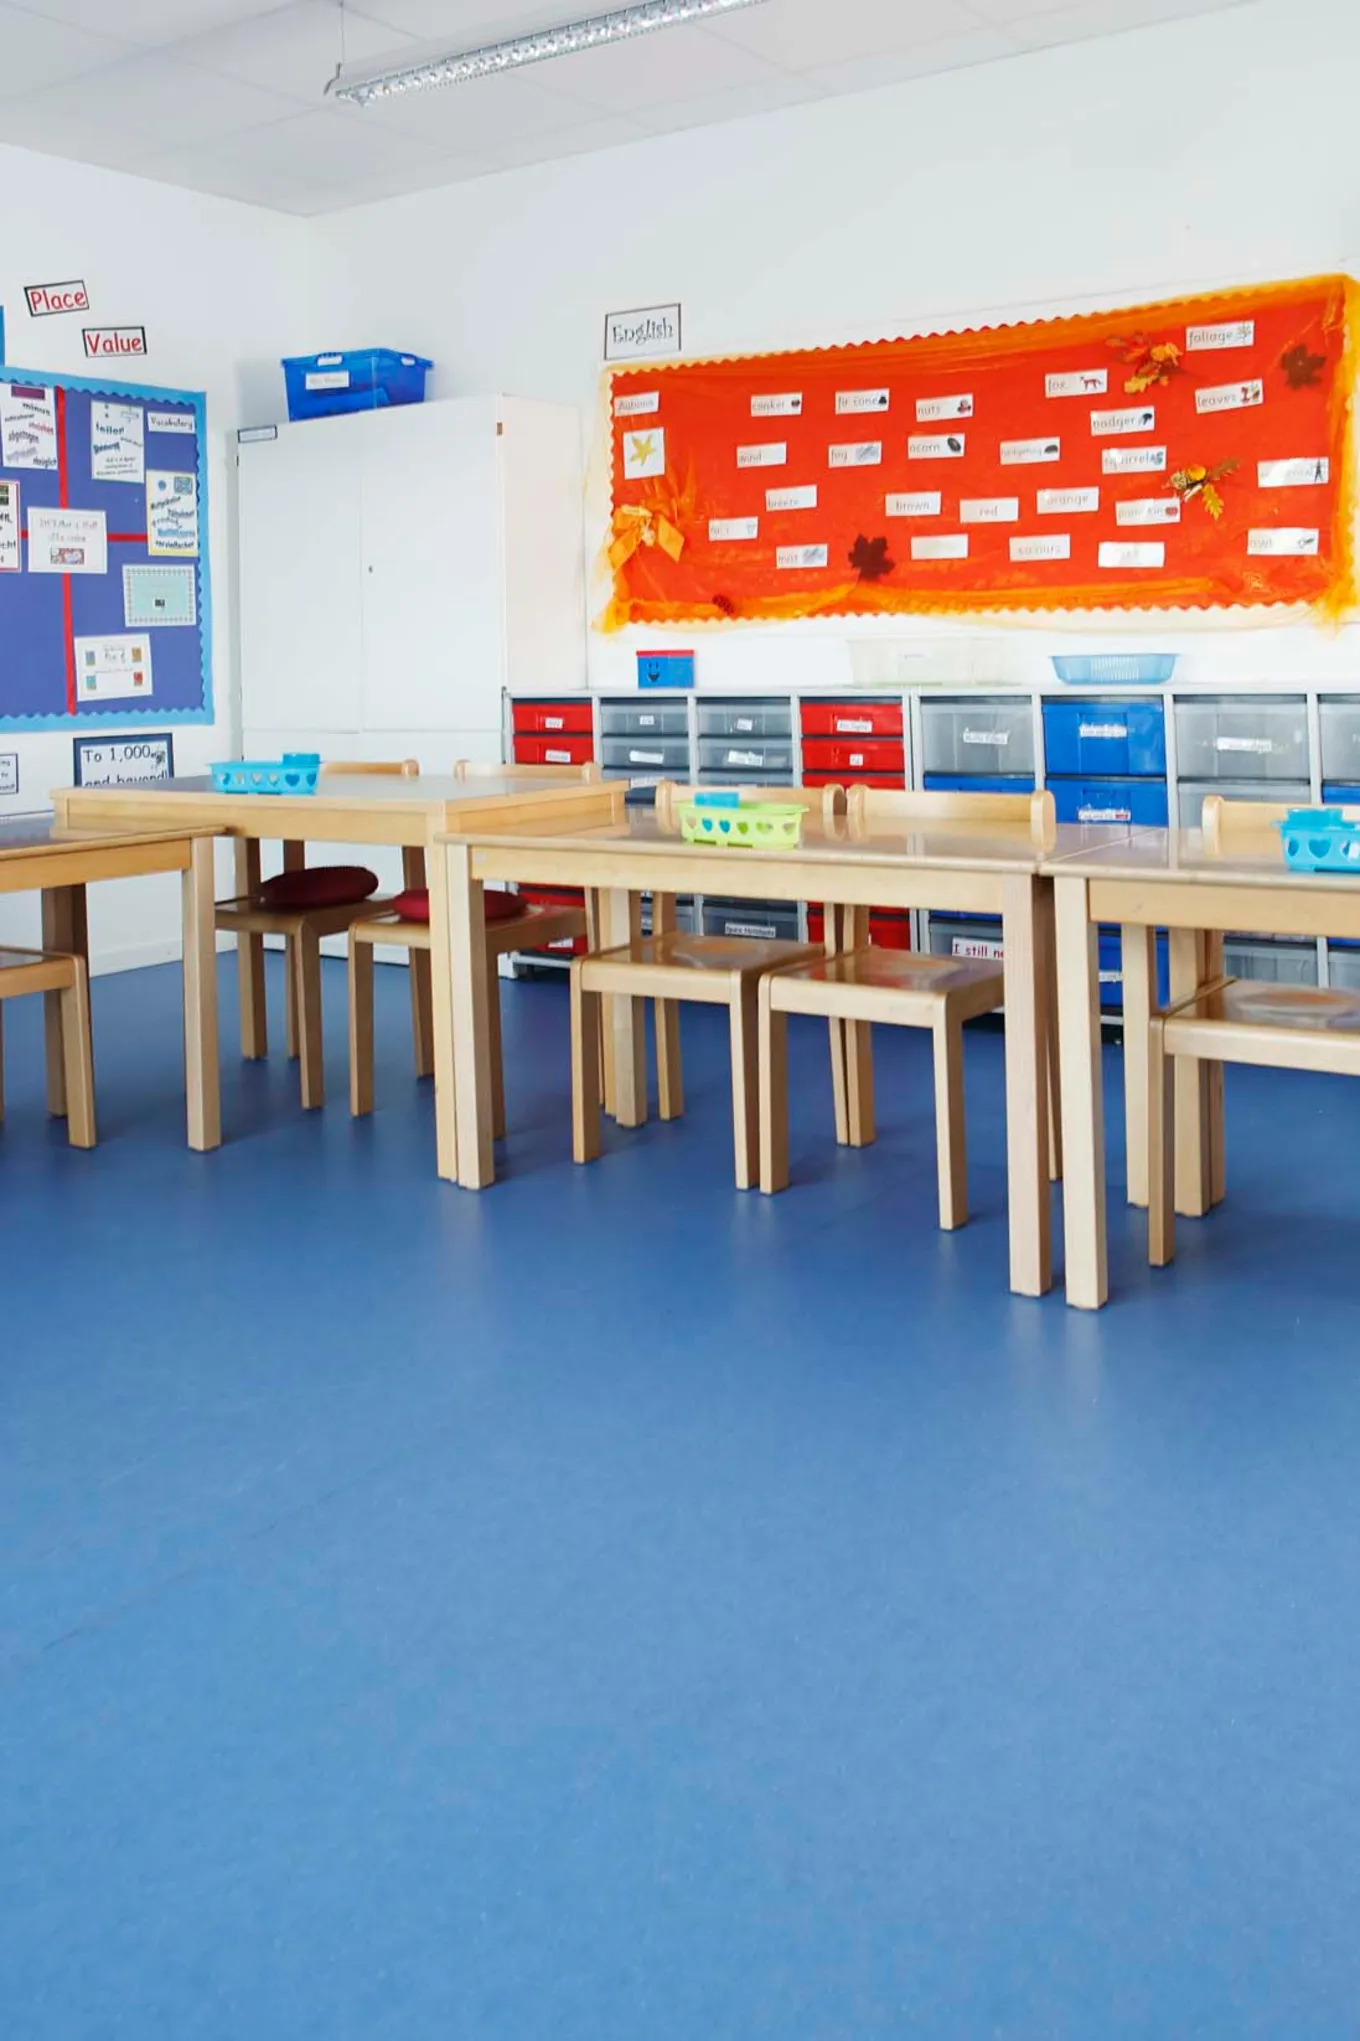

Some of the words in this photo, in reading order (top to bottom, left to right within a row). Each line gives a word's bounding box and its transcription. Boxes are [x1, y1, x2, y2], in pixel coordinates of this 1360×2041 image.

[30, 288, 87, 313] Place
[612, 317, 674, 346] English
[1188, 330, 1233, 347] foliage
[86, 332, 143, 354] Value
[1197, 393, 1237, 407] leaves
[979, 505, 998, 517] red
[82, 750, 102, 763] To
[110, 744, 151, 763] 1,000
[953, 943, 960, 955] I
[965, 945, 988, 958] still
